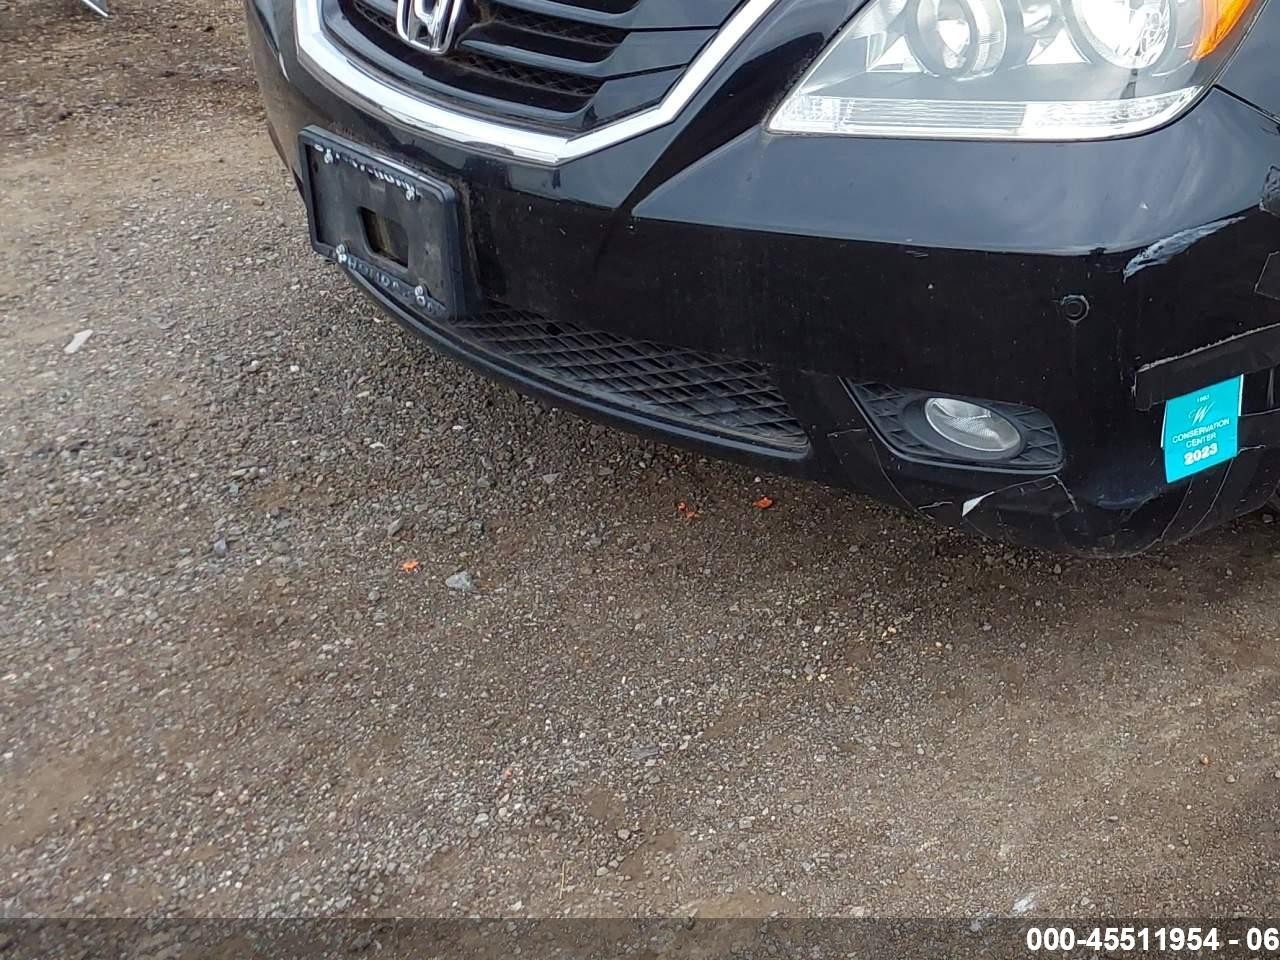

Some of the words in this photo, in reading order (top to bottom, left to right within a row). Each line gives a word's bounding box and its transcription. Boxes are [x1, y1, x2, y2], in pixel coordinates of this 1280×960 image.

[1173, 418, 1230, 443] CONSERVATION
[1185, 432, 1217, 449] CENTER
[1184, 443, 1218, 465] 2023
